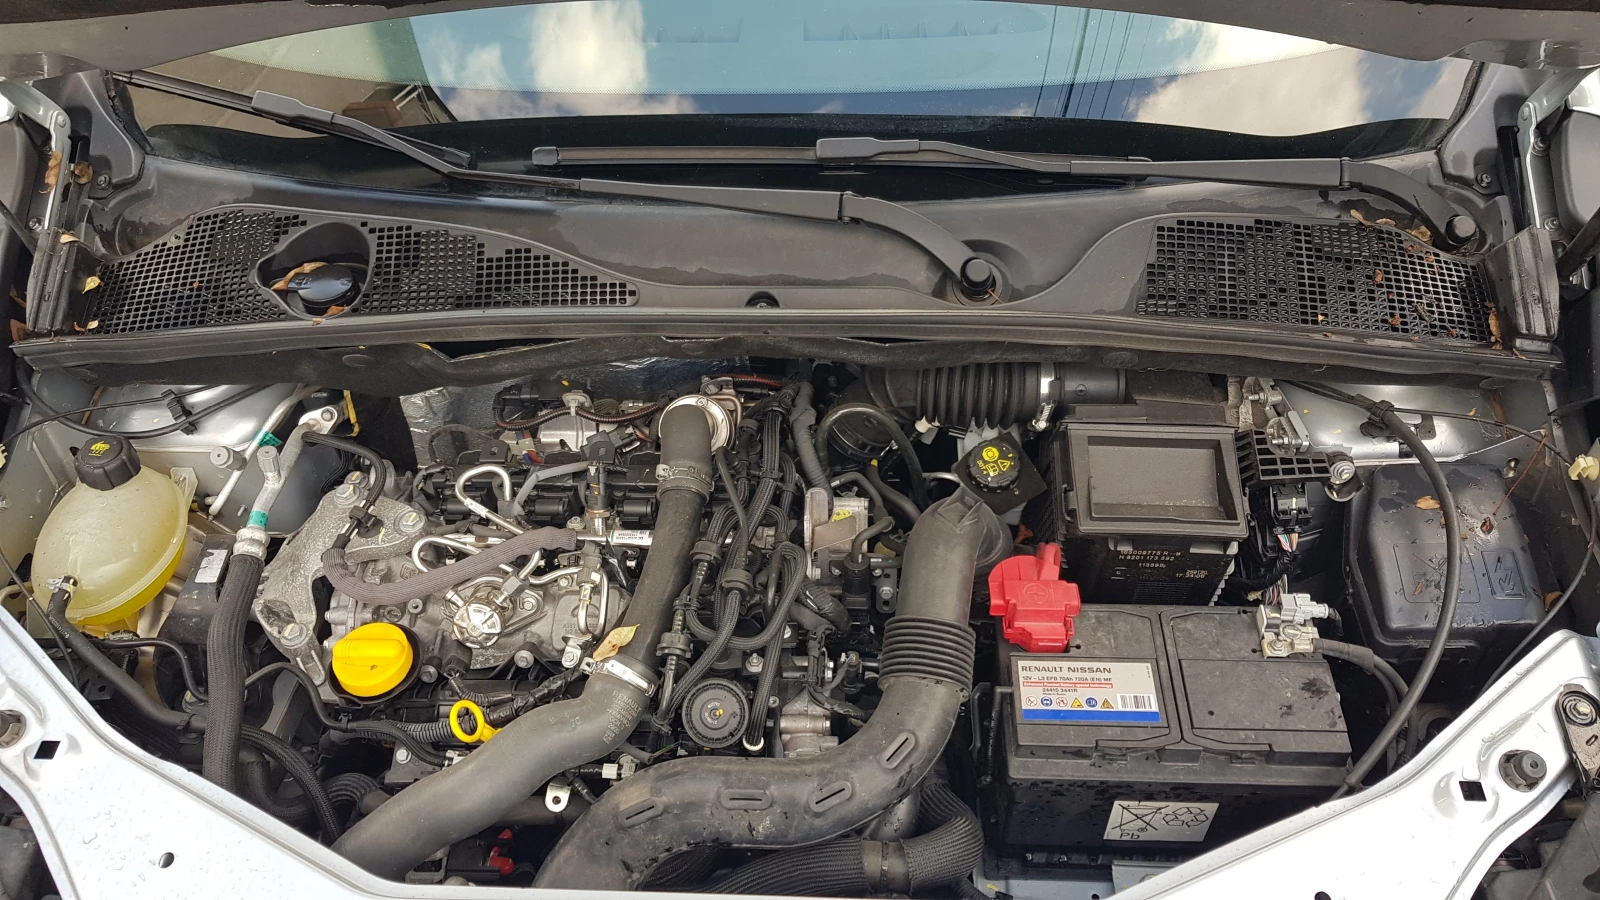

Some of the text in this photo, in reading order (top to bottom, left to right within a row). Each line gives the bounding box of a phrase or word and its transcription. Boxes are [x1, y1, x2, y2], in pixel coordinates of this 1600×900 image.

[977, 460, 986, 470] DOT
[1021, 665, 1111, 674] RENAULT NISSAN
[612, 690, 642, 714] RENAULT
[1119, 832, 1140, 840] Pb
